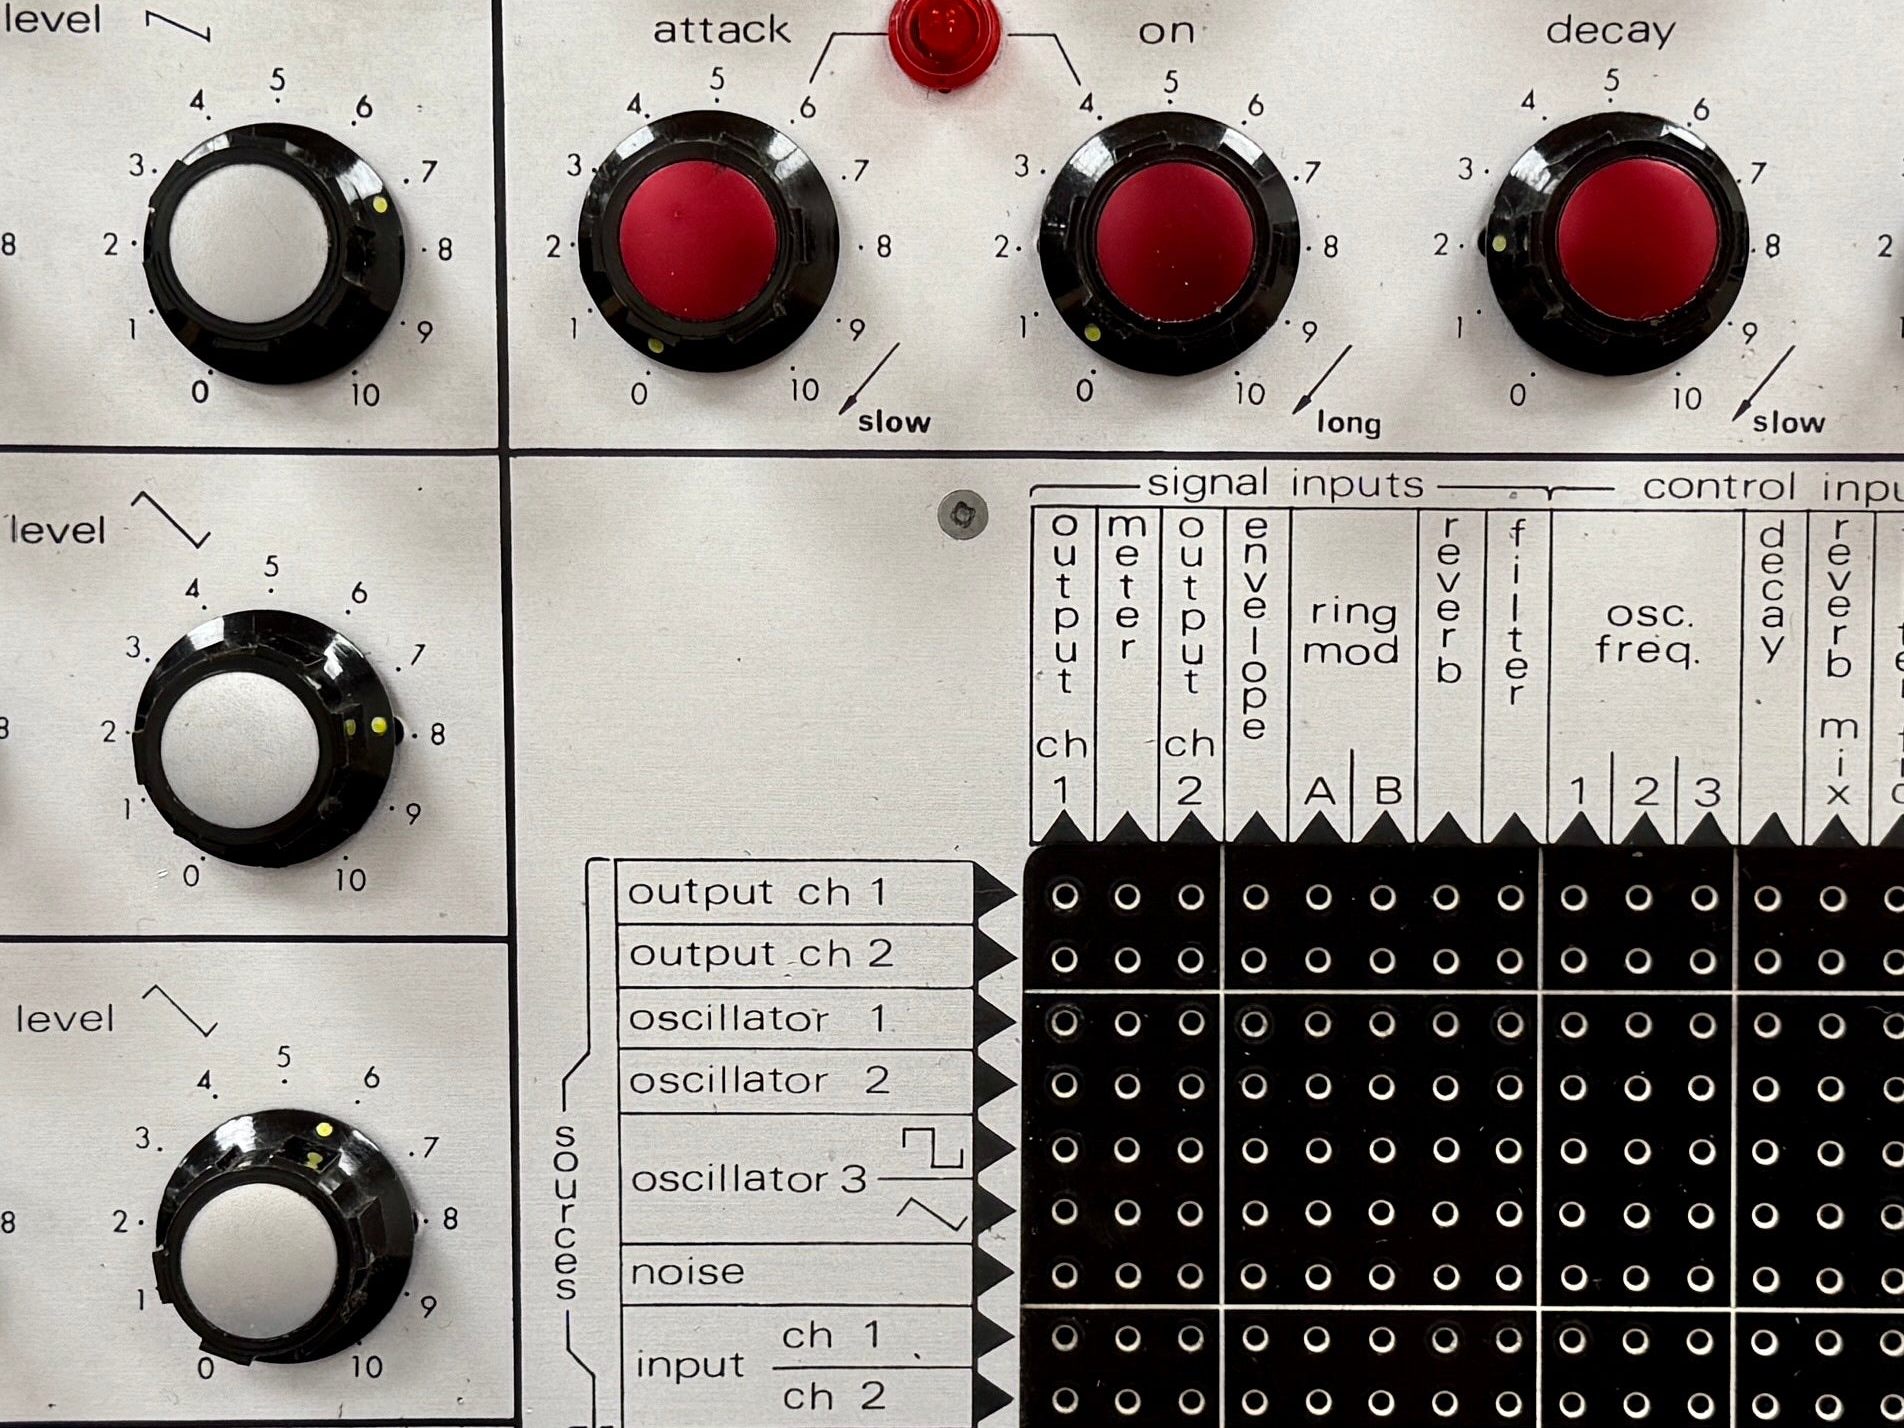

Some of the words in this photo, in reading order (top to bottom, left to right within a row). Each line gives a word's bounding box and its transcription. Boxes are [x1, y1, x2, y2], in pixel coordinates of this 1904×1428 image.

[5, 1, 101, 34] level
[653, 12, 792, 45] attack
[1138, 21, 1195, 45] on
[1546, 13, 1677, 51] decay
[858, 408, 932, 434] slow
[1317, 408, 1381, 441] long
[1753, 409, 1827, 435] slow
[1148, 465, 1268, 504] signal
[1292, 467, 1424, 504] inputs
[1643, 470, 1796, 501] control
[1312, 594, 1397, 634] ring
[1607, 604, 1694, 628] osc.
[1303, 633, 1399, 666] mod
[1594, 633, 1700, 671] freq.
[628, 878, 774, 912] output
[798, 876, 850, 907] ch
[871, 877, 884, 906] 1
[629, 1003, 830, 1033] oscillator
[871, 1003, 884, 1033] 1
[631, 1162, 829, 1194] oscillator
[840, 1163, 867, 1194] 3
[631, 1255, 745, 1286] noise
[637, 1349, 745, 1385] input
